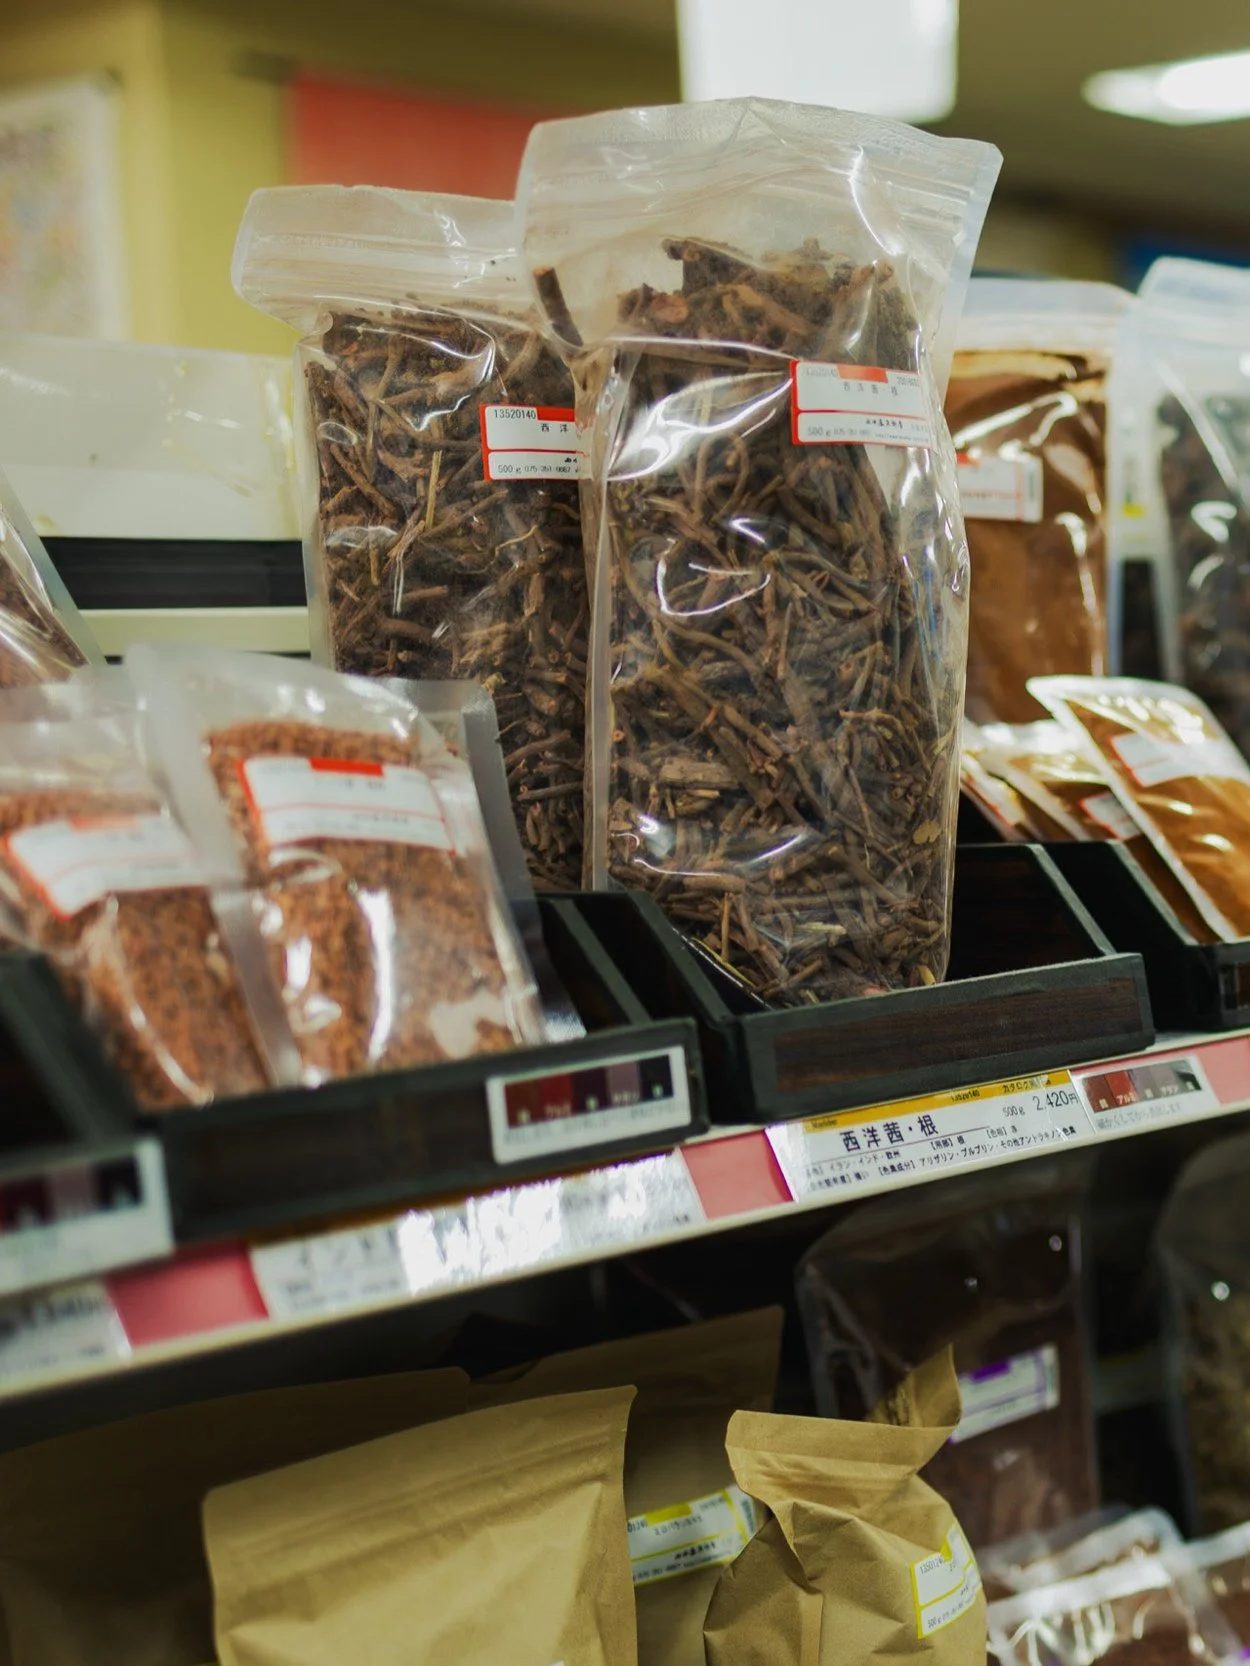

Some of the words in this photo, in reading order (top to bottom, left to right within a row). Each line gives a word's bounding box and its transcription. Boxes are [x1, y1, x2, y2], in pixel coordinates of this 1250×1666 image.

[494, 409, 536, 419] 13520140
[840, 1114, 939, 1152] 西洋茜・根
